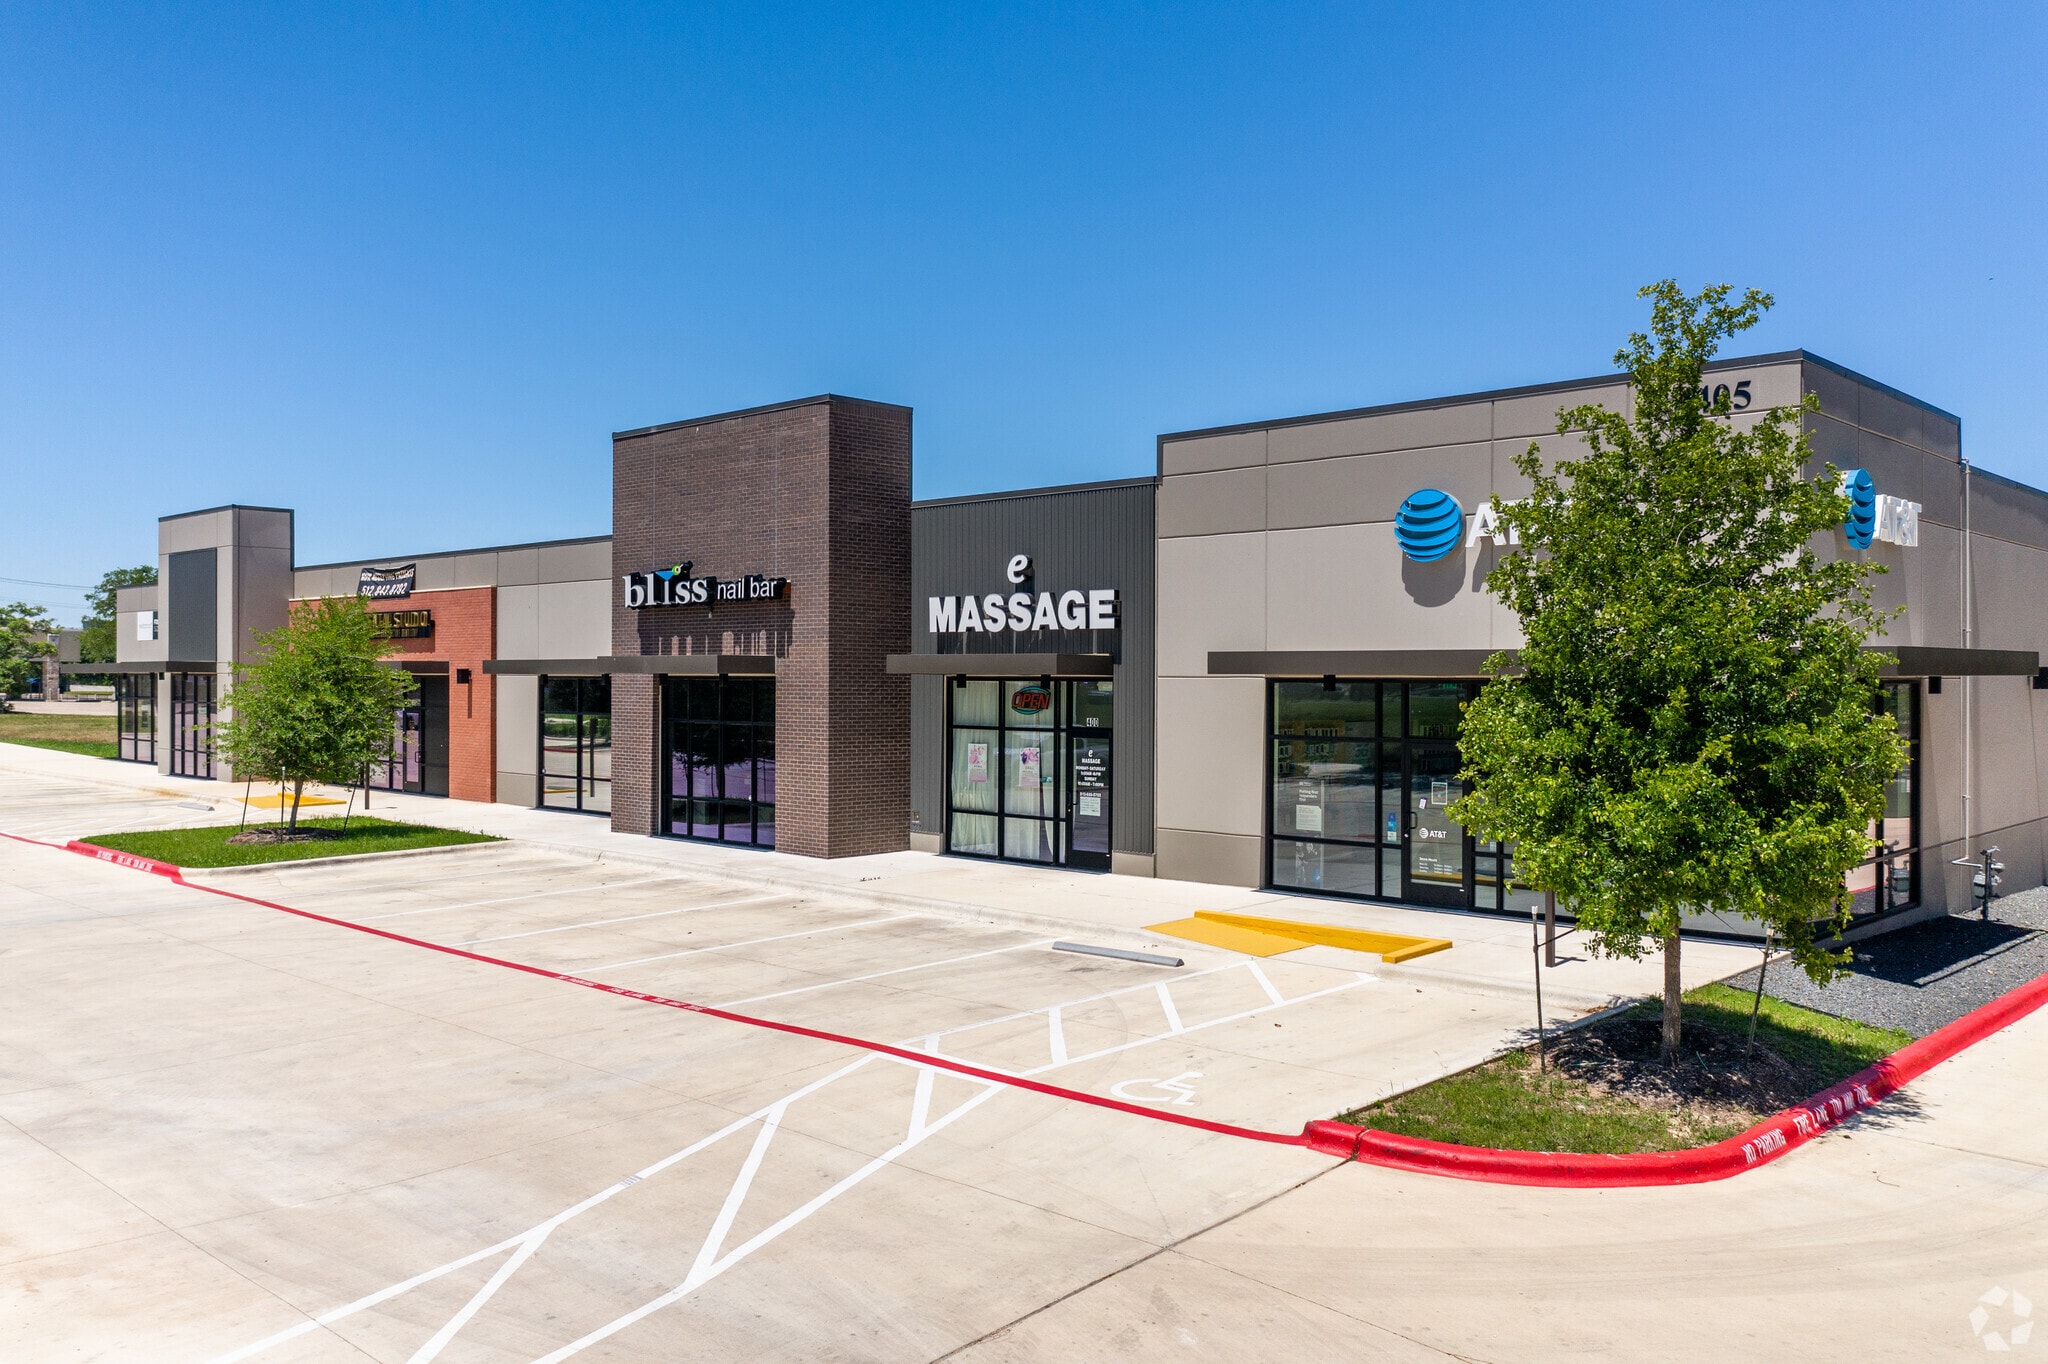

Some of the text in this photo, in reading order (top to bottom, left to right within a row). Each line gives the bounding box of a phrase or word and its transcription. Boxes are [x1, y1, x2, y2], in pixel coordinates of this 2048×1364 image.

[1873, 494, 1922, 547] AT&T
[1007, 554, 1028, 584] e
[622, 570, 778, 608] bliss nail bar
[928, 589, 1115, 633] MASSAGE
[1011, 692, 1050, 709] OPEN
[1429, 830, 1447, 839] AT&T
[1741, 1143, 1757, 1165] NO
[1753, 1128, 1786, 1158] PARKING
[1792, 1113, 1812, 1136] FIRE
